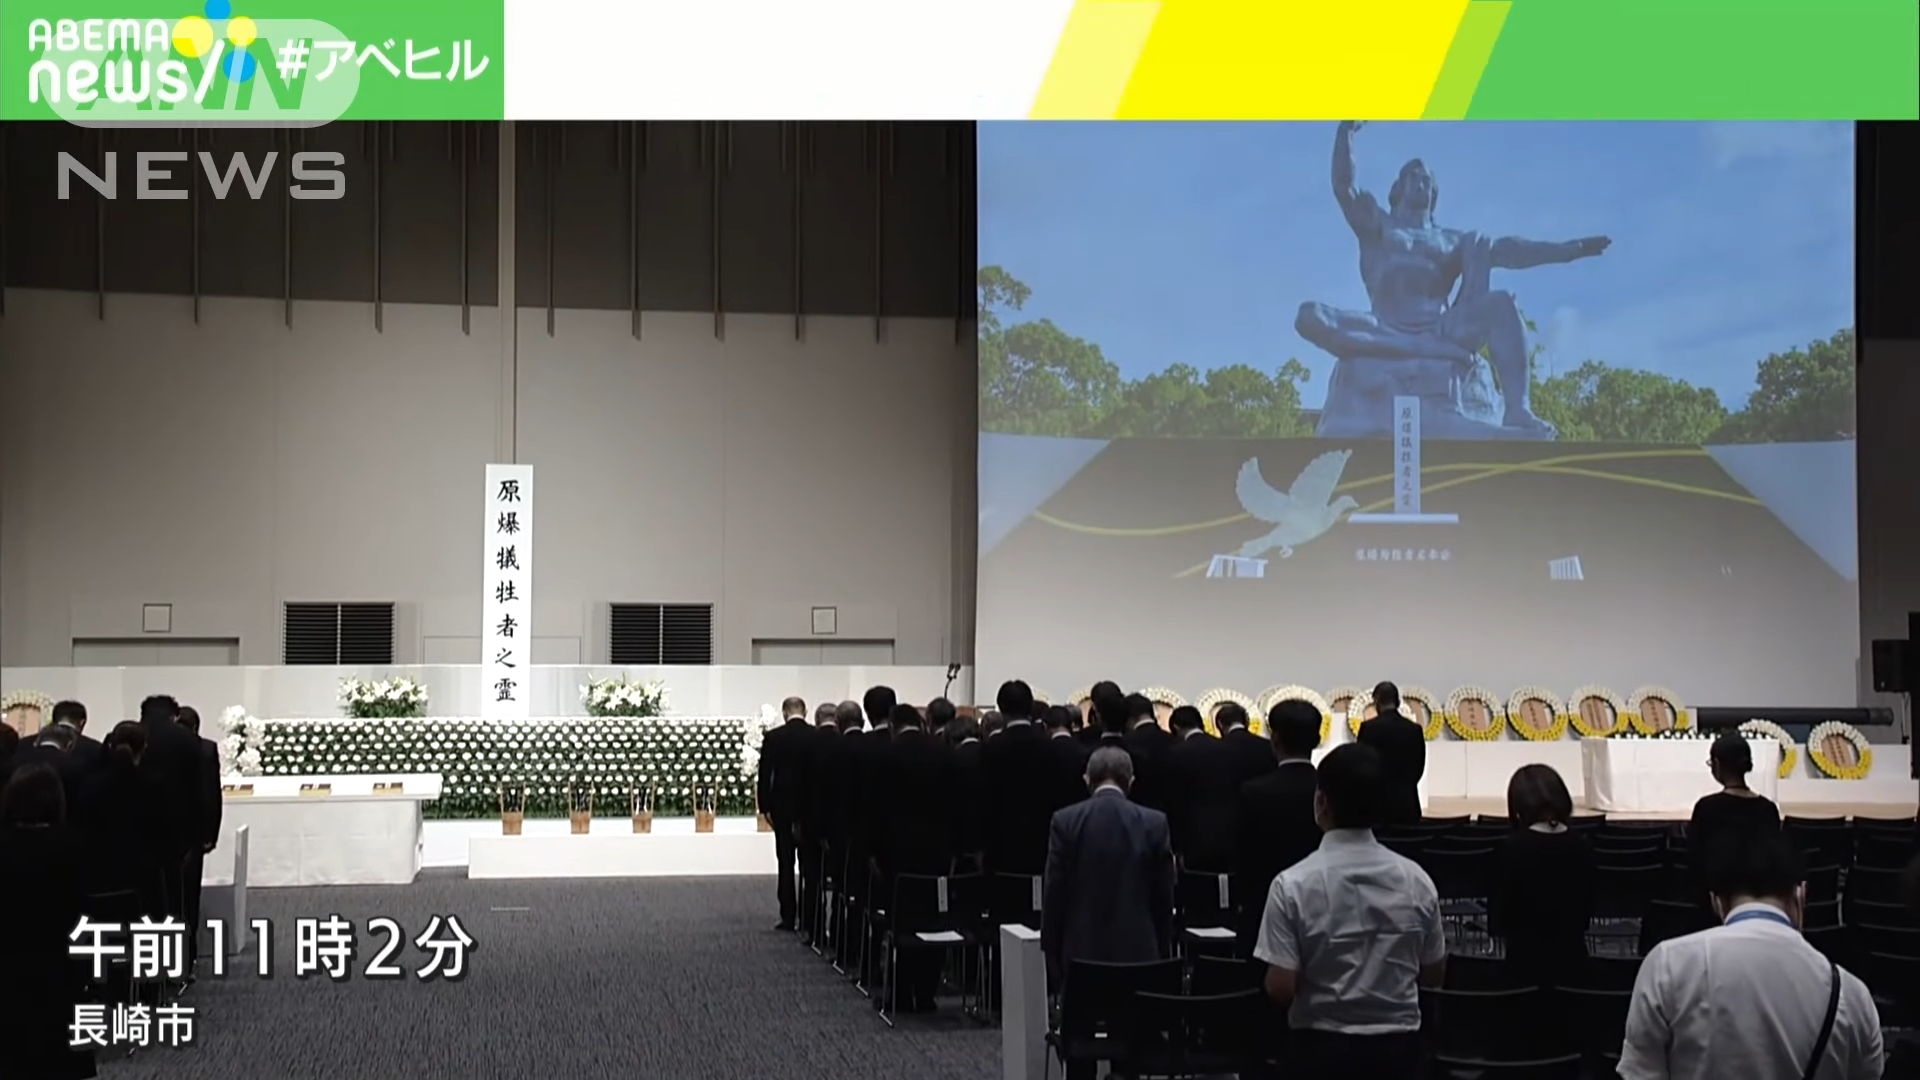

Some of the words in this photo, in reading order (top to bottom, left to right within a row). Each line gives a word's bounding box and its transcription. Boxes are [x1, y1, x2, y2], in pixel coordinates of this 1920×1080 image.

[494, 479, 522, 703] 原爆犠牲者之霊
